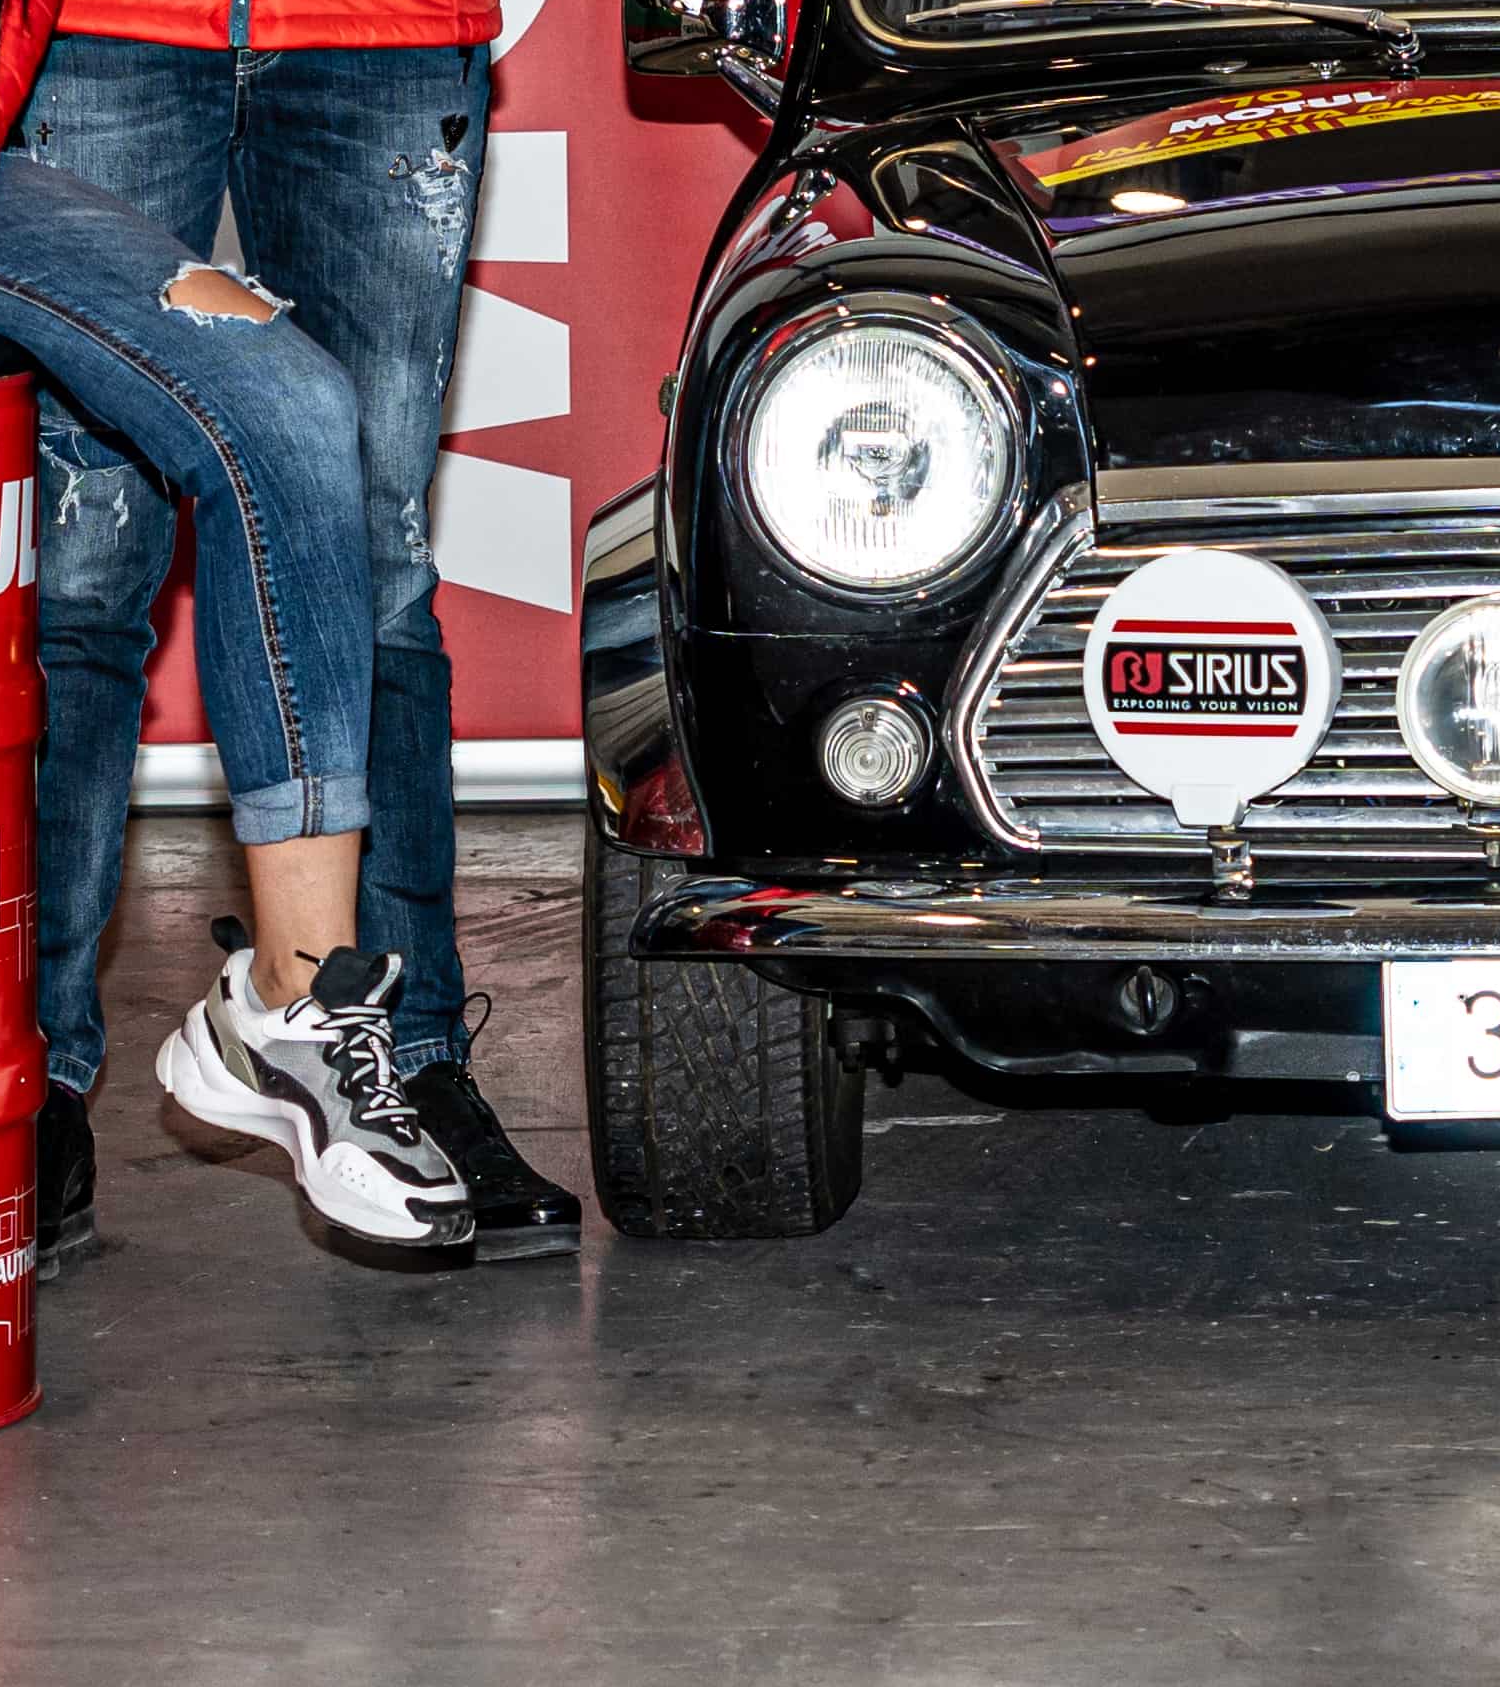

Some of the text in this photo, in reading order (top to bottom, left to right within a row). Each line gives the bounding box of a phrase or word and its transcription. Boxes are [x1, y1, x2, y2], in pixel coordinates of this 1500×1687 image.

[1169, 91, 1387, 134] MOTUL
[1220, 90, 1303, 108] 70
[1072, 130, 1204, 168] RALLY
[1212, 109, 1349, 136] COSTA
[1168, 652, 1298, 696] SIRIUS
[1113, 698, 1299, 713] EXPLORING YOUR VISION
